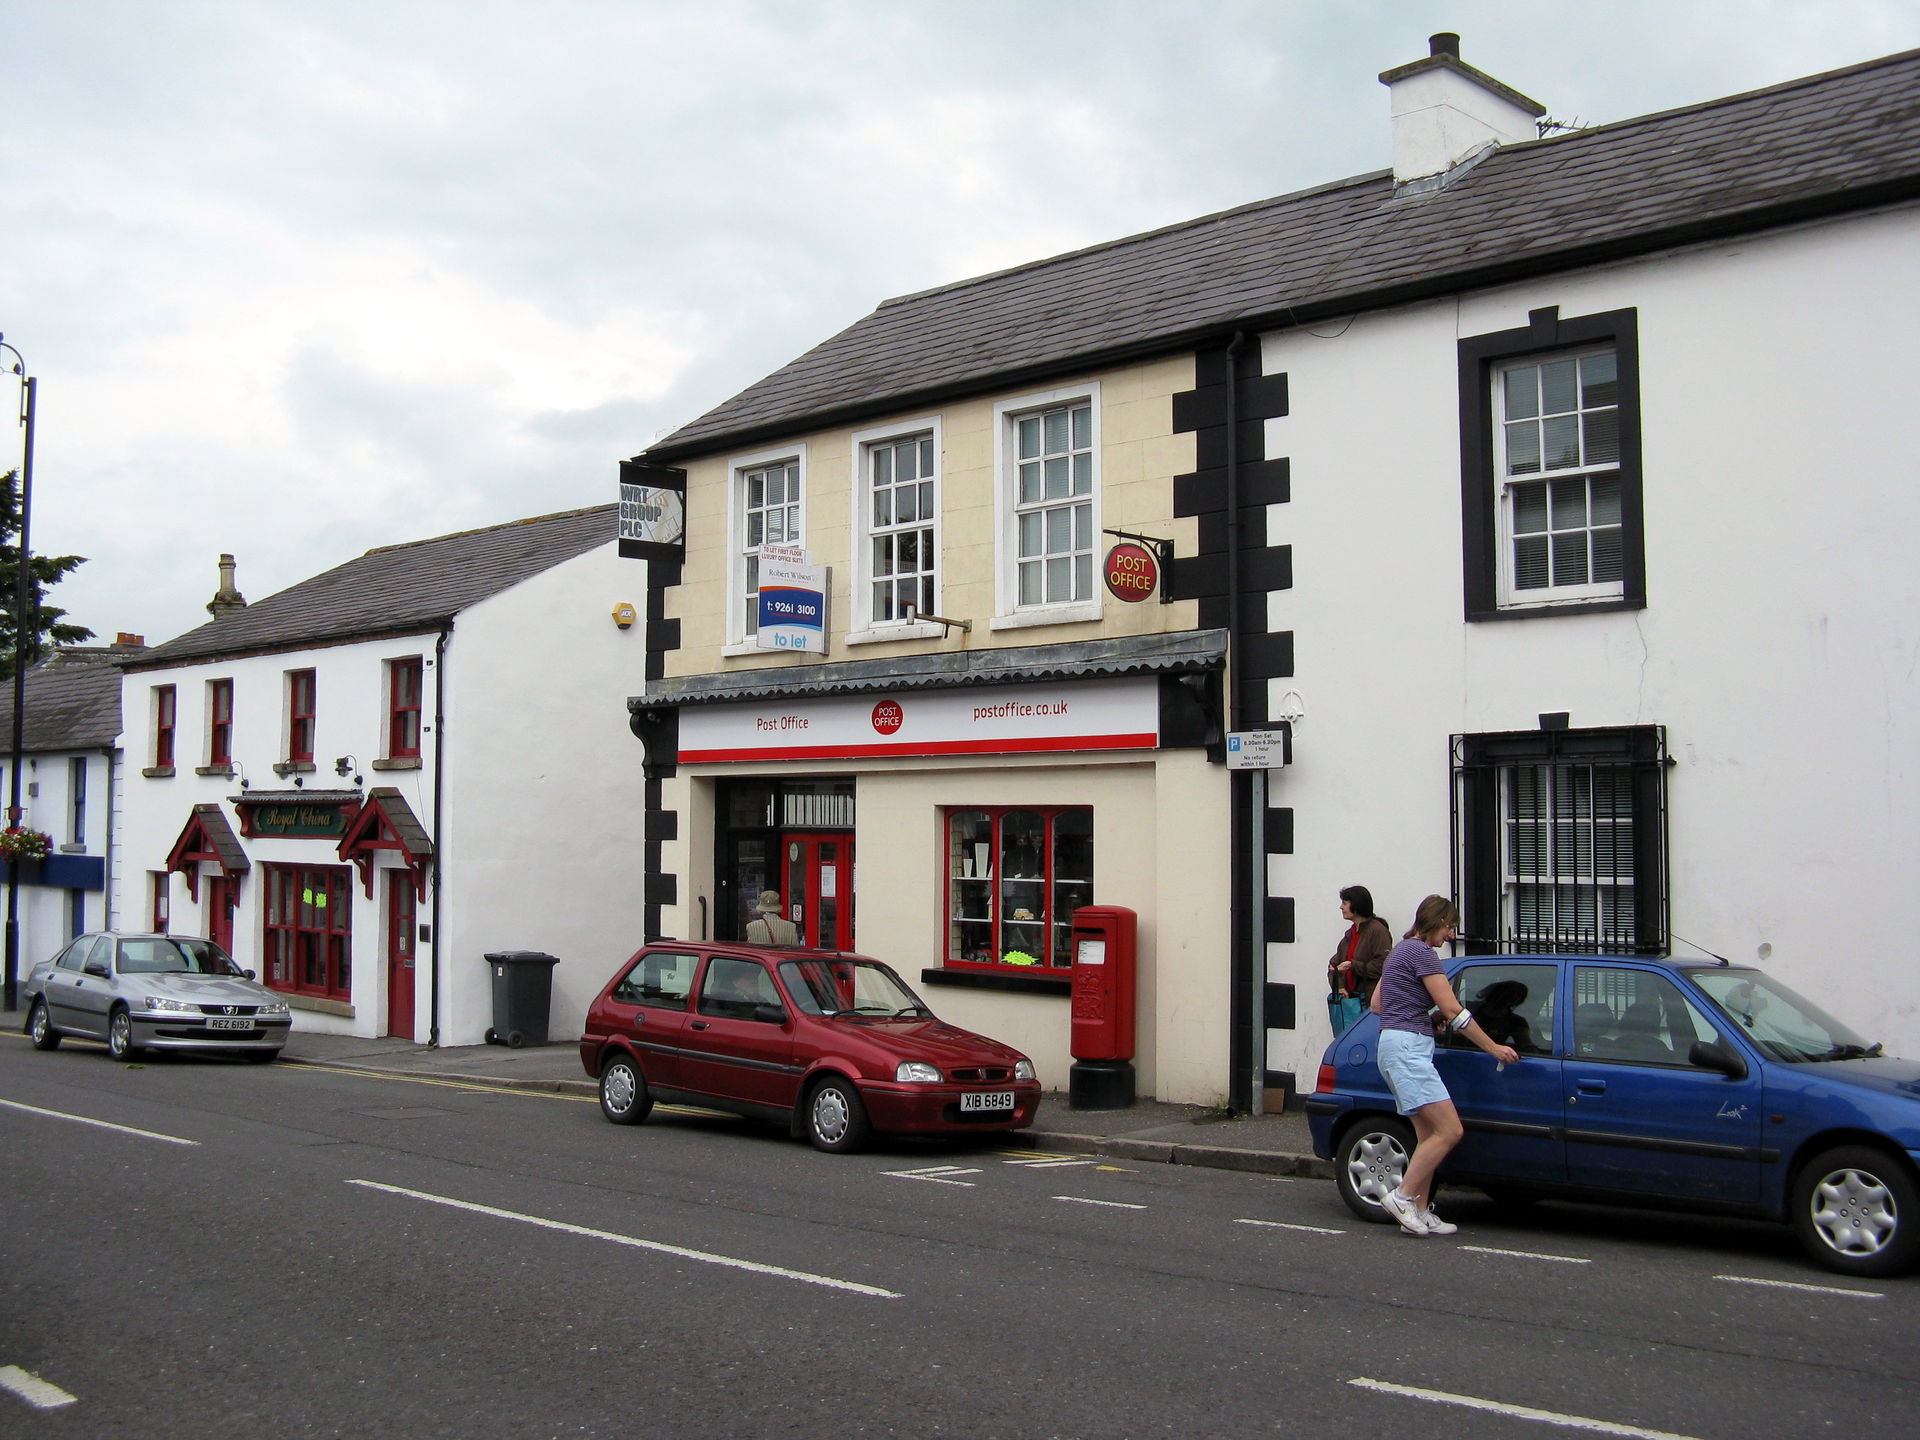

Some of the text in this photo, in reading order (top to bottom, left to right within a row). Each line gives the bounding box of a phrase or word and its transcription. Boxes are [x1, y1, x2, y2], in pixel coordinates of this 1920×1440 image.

[620, 484, 649, 503] WRT
[620, 502, 662, 522] GROUP
[620, 520, 642, 538] PLC
[1116, 555, 1147, 572] POST
[768, 568, 790, 579] Robert
[791, 571, 811, 581] Wilson
[1110, 571, 1151, 590] OFFICE
[767, 601, 816, 616] t: 9261 3100
[774, 632, 807, 648] to let
[878, 707, 897, 717] POST
[973, 699, 1068, 722] postoffice.co.uk
[756, 716, 809, 731] Post Office
[874, 716, 900, 727] OFFICE
[1231, 738, 1238, 750] P
[267, 806, 331, 832] Royal China
[212, 1019, 251, 1029] REZ 6192
[965, 1093, 1012, 1108] XIB 6849
